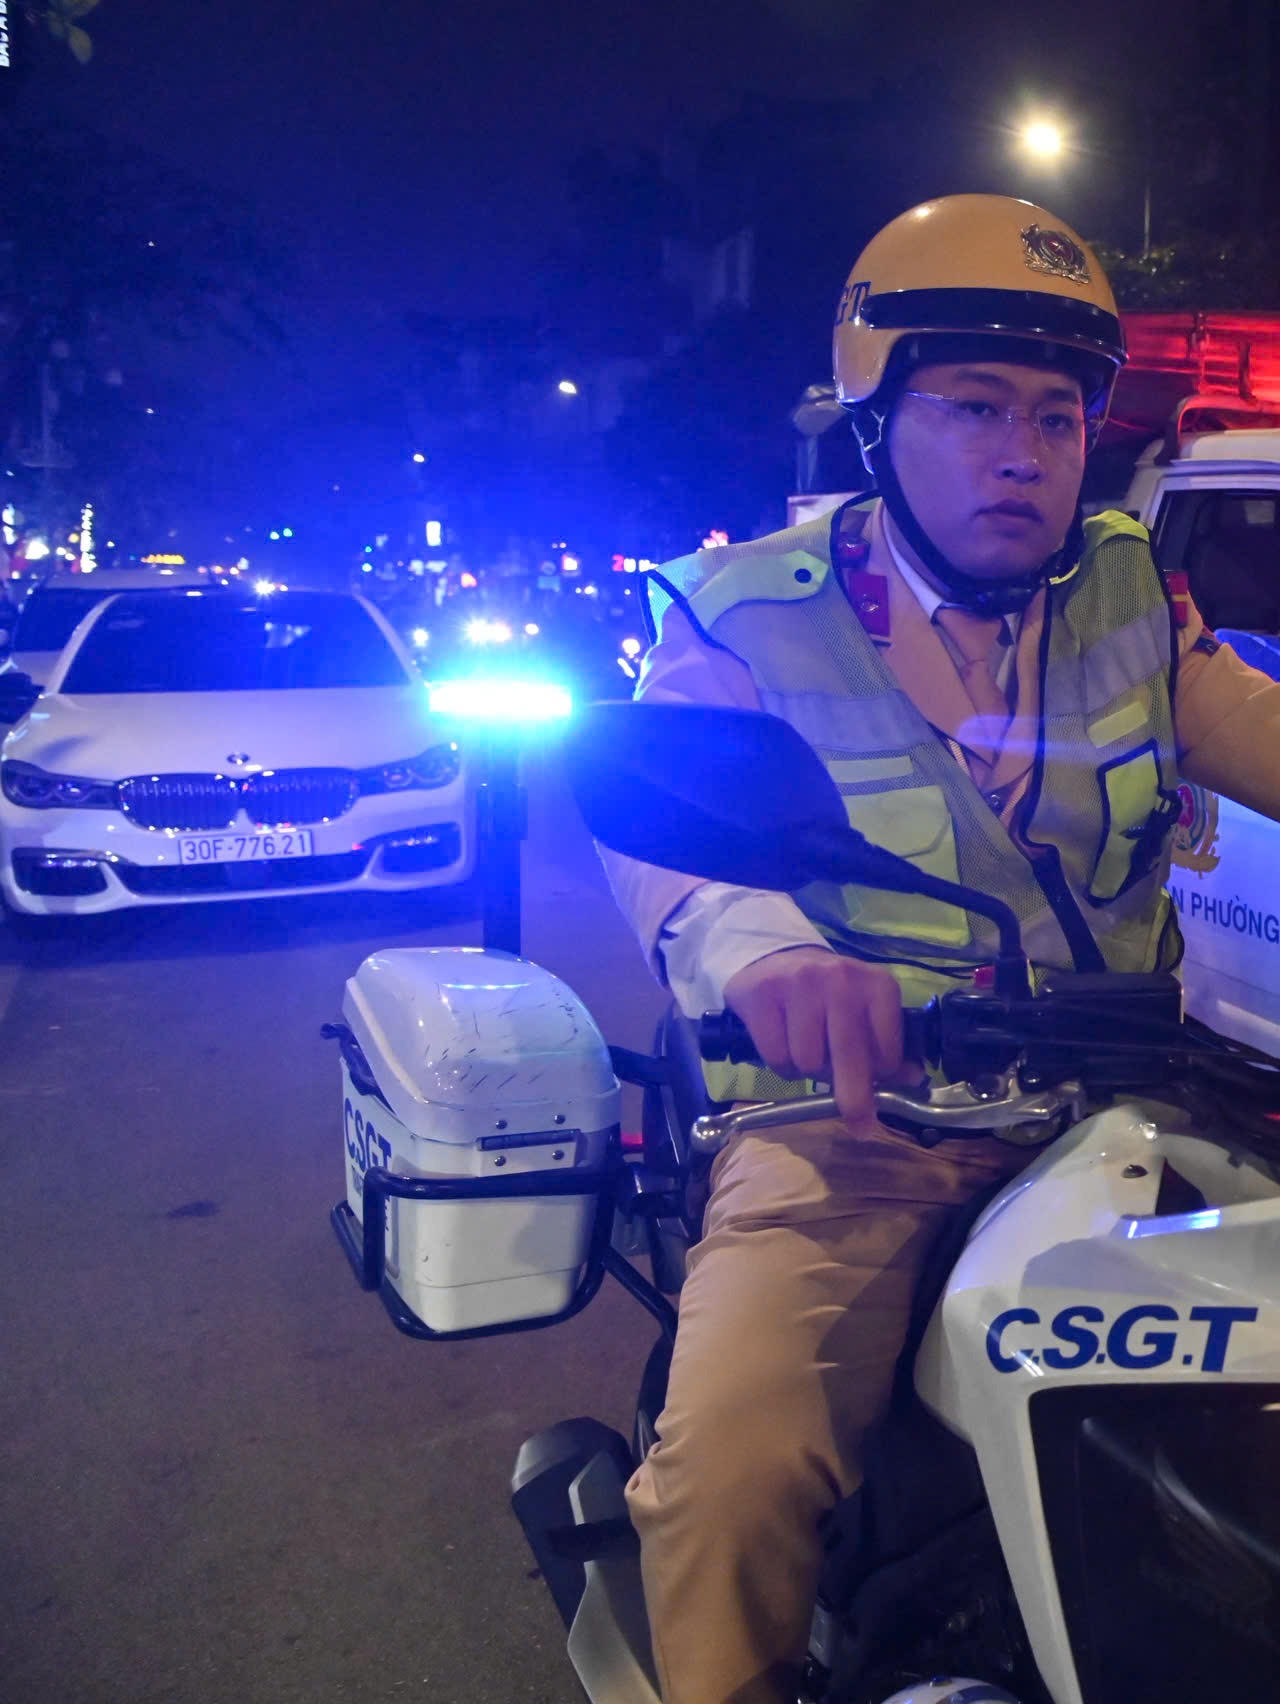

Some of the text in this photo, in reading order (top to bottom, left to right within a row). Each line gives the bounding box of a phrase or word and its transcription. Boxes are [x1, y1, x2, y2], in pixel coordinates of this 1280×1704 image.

[183, 833, 308, 862] 30F-776.21
[1191, 892, 1280, 944] PHƯỜNG
[345, 1097, 392, 1172] CSGT
[986, 1304, 1259, 1374] C.S.G.T
